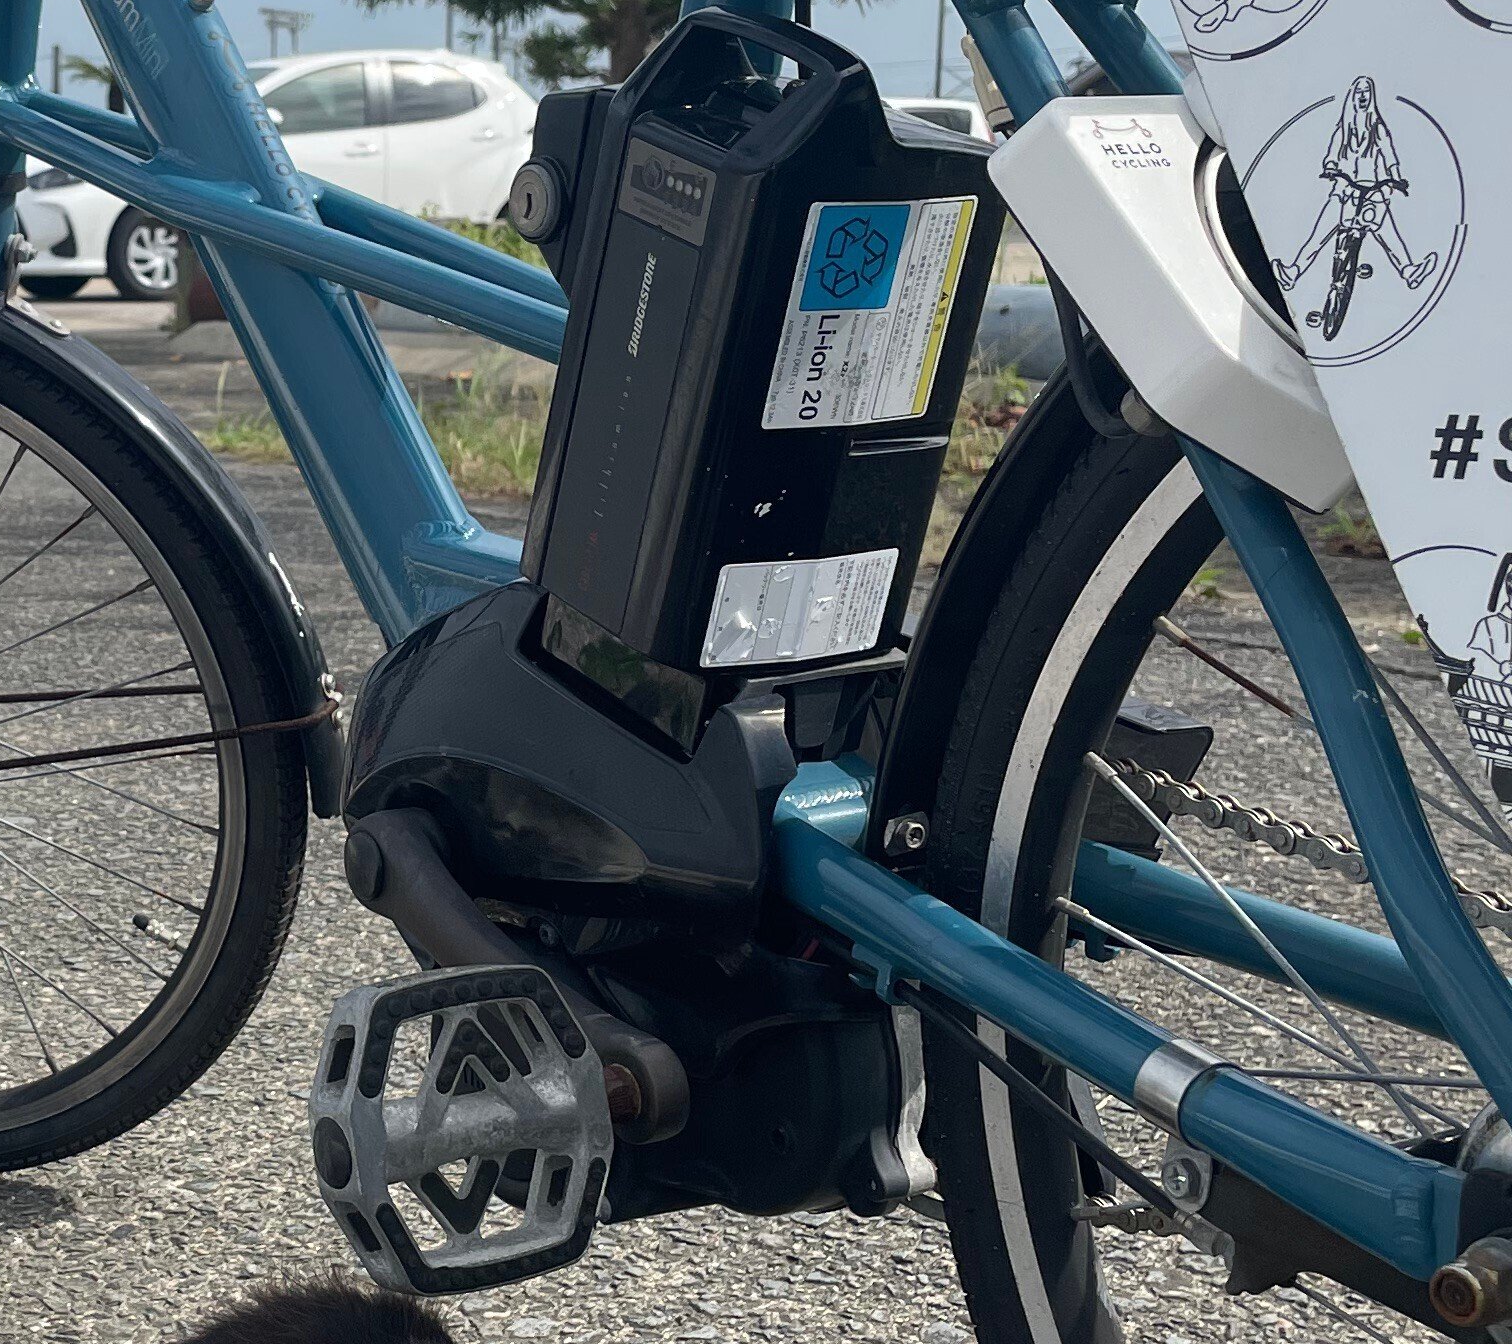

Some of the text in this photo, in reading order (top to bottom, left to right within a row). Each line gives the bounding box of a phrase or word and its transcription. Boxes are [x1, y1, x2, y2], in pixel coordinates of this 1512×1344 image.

[246, 102, 293, 177] HELLO
[1100, 143, 1162, 155] HELLO
[1111, 158, 1171, 169] CYCLING
[627, 252, 657, 358] BRIDGESTONE
[796, 313, 841, 421] Li-ion 20
